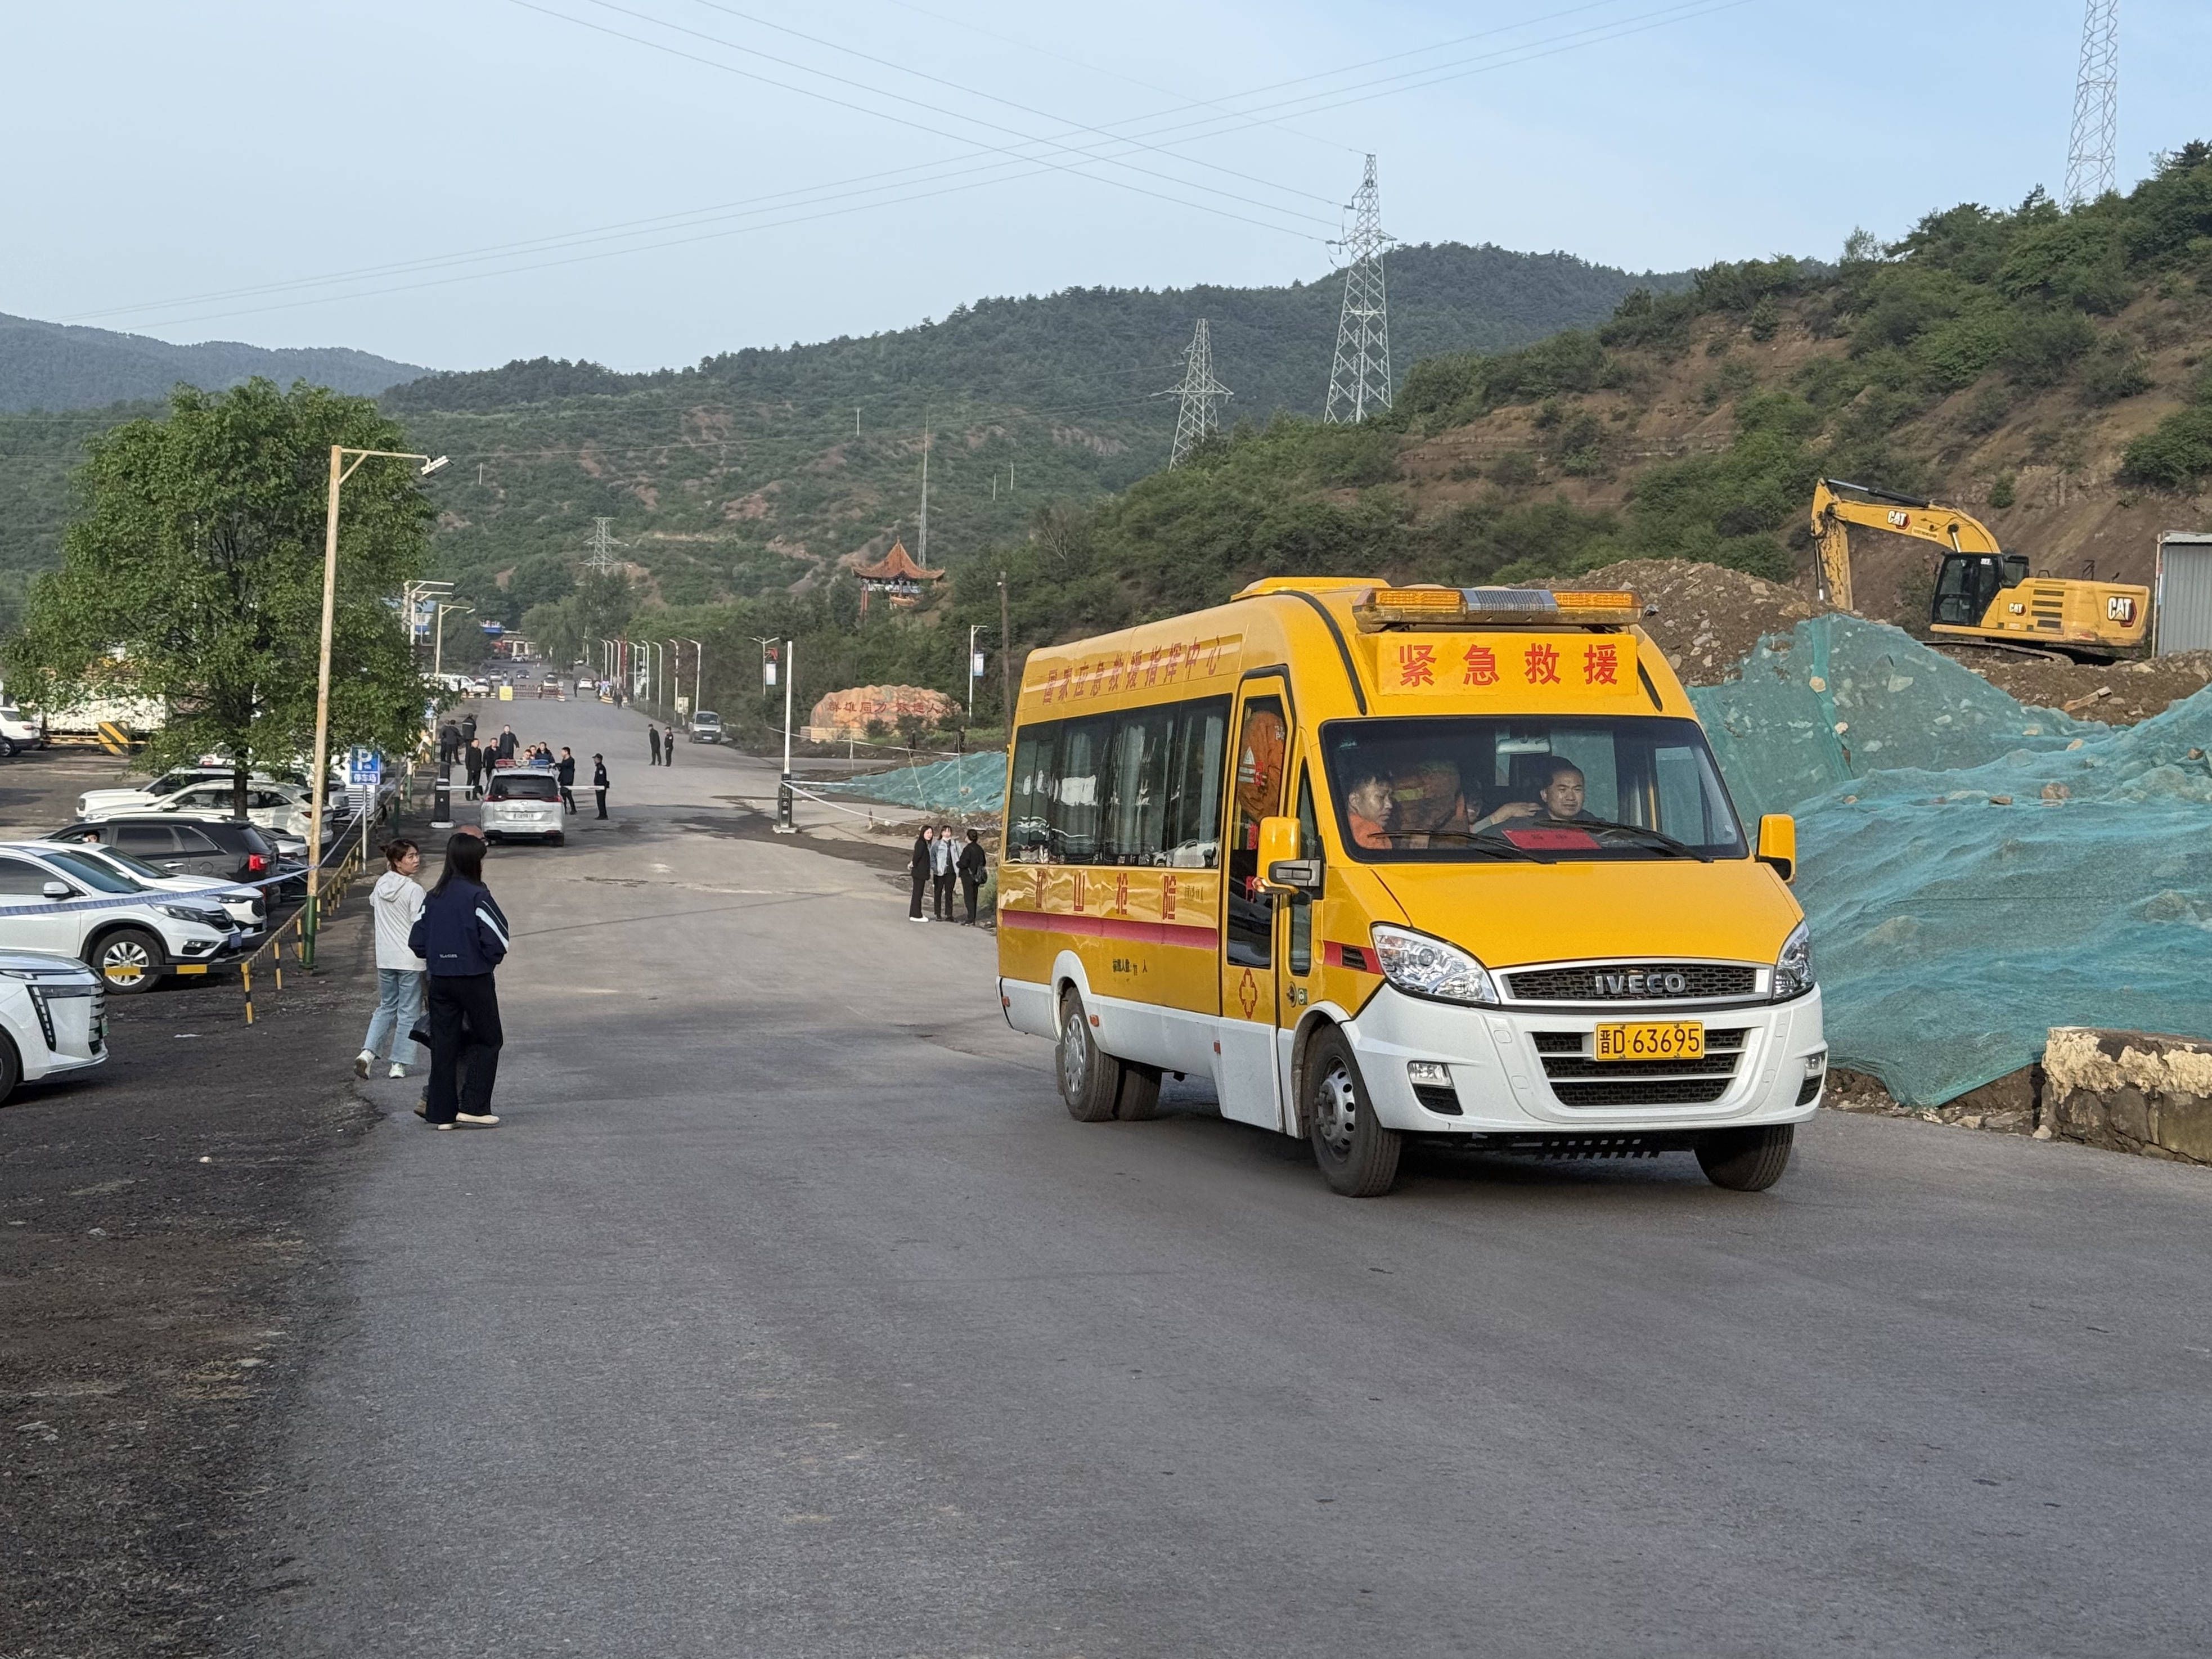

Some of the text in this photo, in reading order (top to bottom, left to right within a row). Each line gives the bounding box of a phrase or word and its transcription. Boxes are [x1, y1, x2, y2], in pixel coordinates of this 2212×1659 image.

[1887, 510, 1907, 526] CAT
[2008, 603, 2023, 613] CAT
[2107, 596, 2132, 621] CAT
[1399, 643, 1618, 687] 紧急救援
[357, 749, 372, 771] P
[354, 774, 376, 783] 停车场
[1036, 870, 1177, 920] 矿山抢险
[1595, 973, 1686, 995] IVECO
[1599, 1028, 1700, 1054] 晋D·63695
